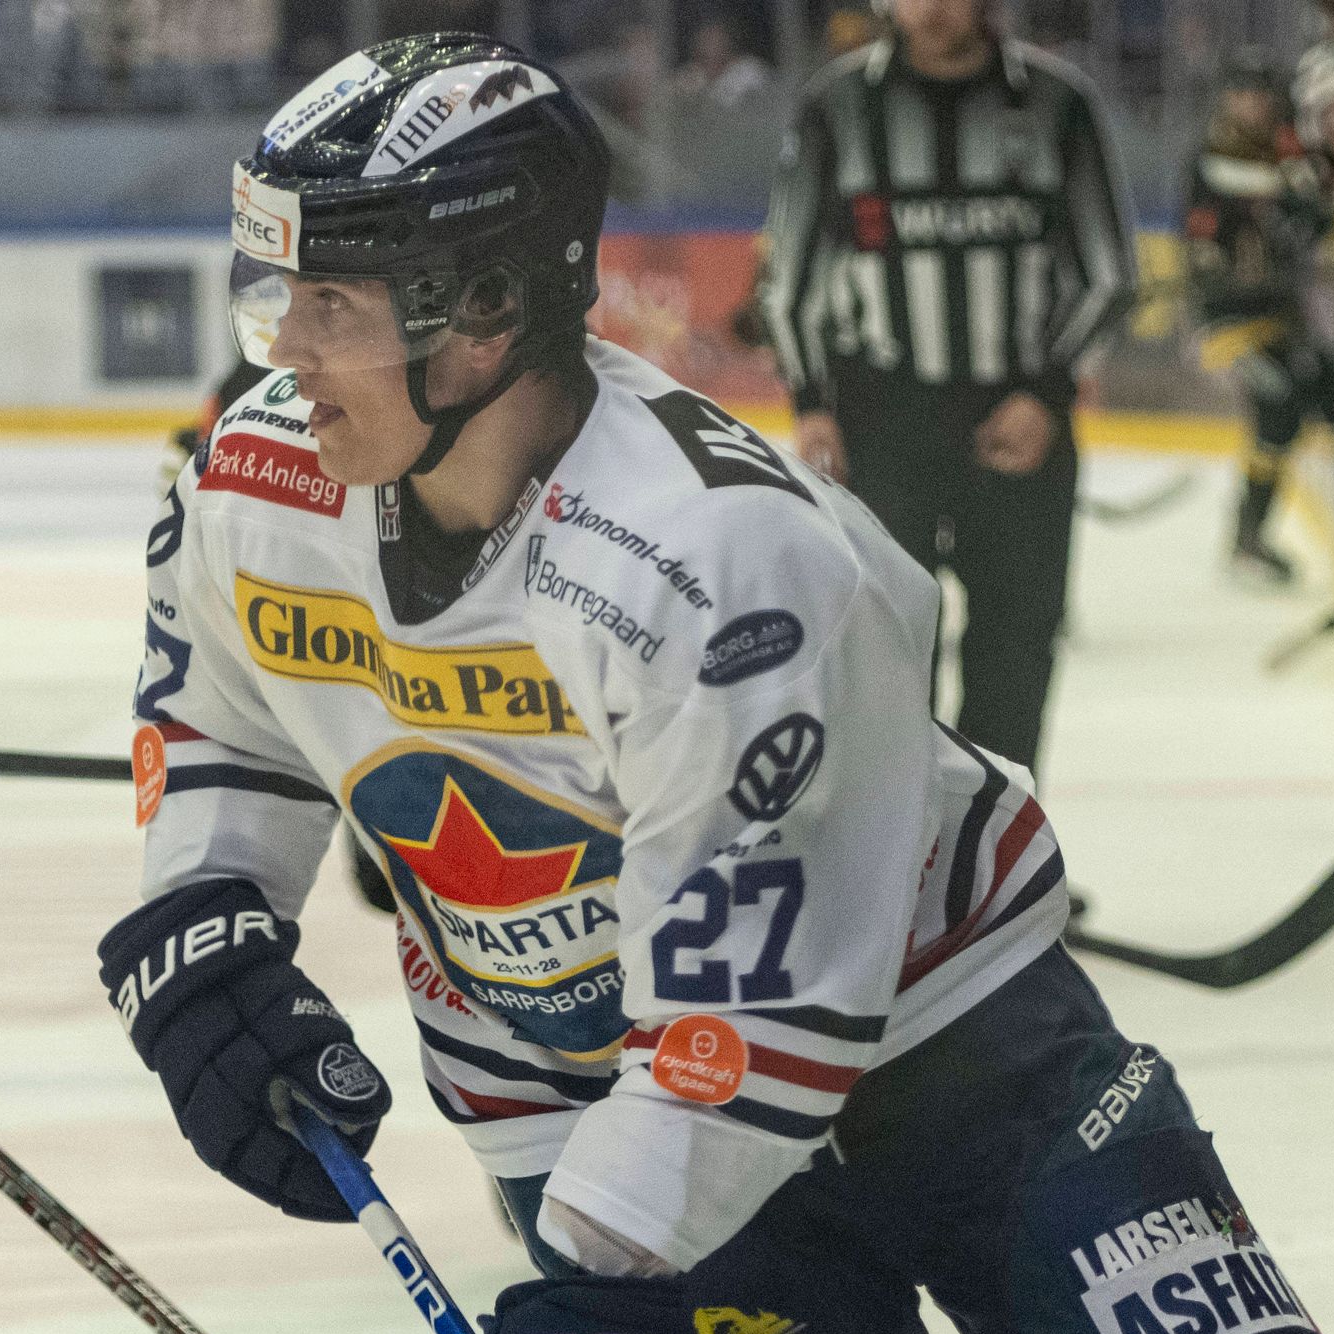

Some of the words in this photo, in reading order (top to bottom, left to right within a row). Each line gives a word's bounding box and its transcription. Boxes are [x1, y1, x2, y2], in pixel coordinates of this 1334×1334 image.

[378, 95, 452, 168] THIB
[209, 449, 241, 475] Park
[241, 452, 256, 479] &
[257, 457, 338, 506] Anlegg
[537, 559, 665, 664] Borregaard
[116, 910, 279, 1035] AUER
[430, 894, 621, 957] SPARTA
[651, 857, 805, 1004] 27
[1070, 1197, 1218, 1291] LARSEN
